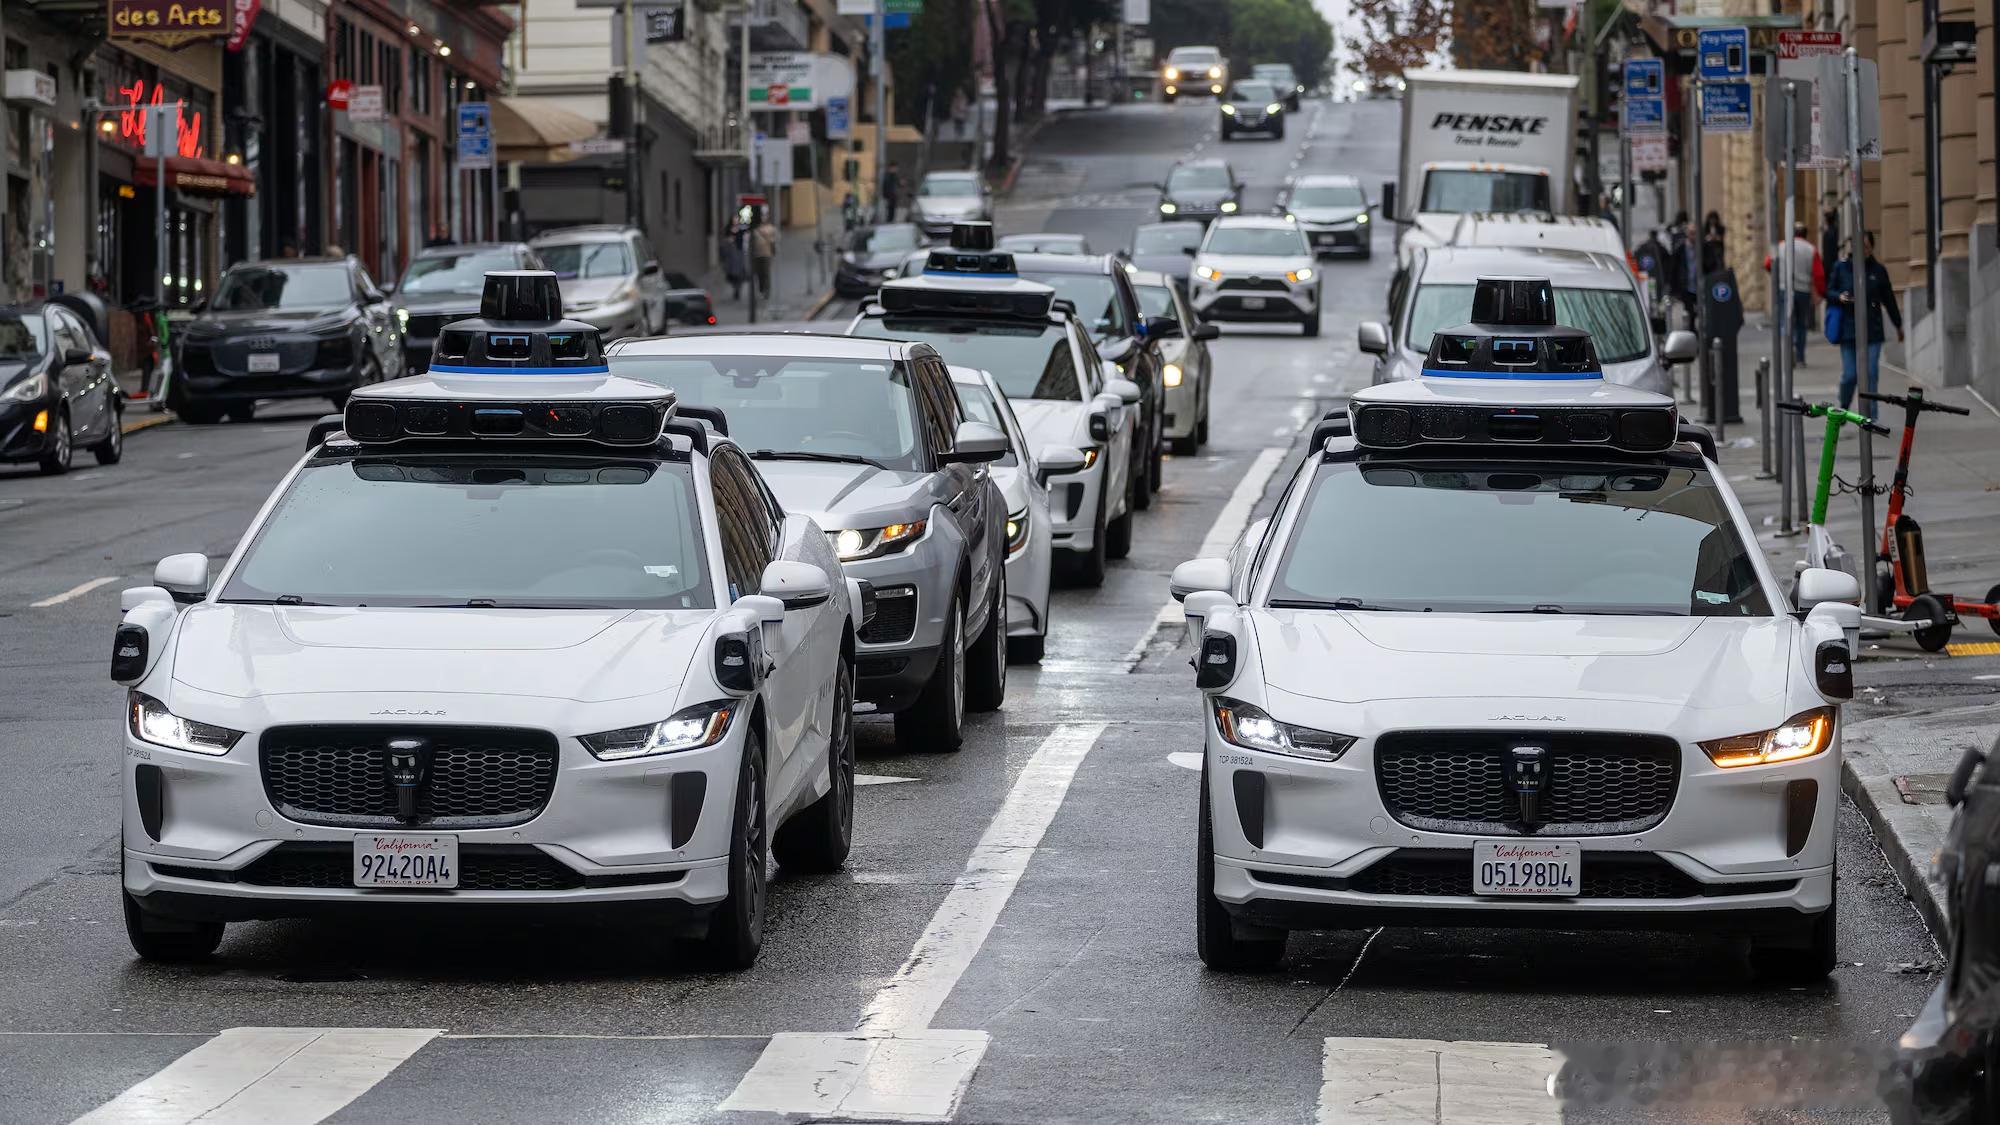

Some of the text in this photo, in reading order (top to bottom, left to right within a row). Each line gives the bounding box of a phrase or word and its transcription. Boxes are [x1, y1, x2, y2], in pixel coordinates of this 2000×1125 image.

[115, 5, 160, 26] des
[167, 3, 223, 26] Arts
[1701, 34, 1720, 46] Pay
[1720, 33, 1744, 43] here
[1780, 43, 1797, 57] NO
[1431, 112, 1548, 135] PENSKE
[1230, 756, 1253, 765] 38152A
[375, 837, 438, 854] California
[1495, 844, 1560, 861] California
[361, 854, 450, 880] 92420A4
[1481, 861, 1573, 888] 05198D4
